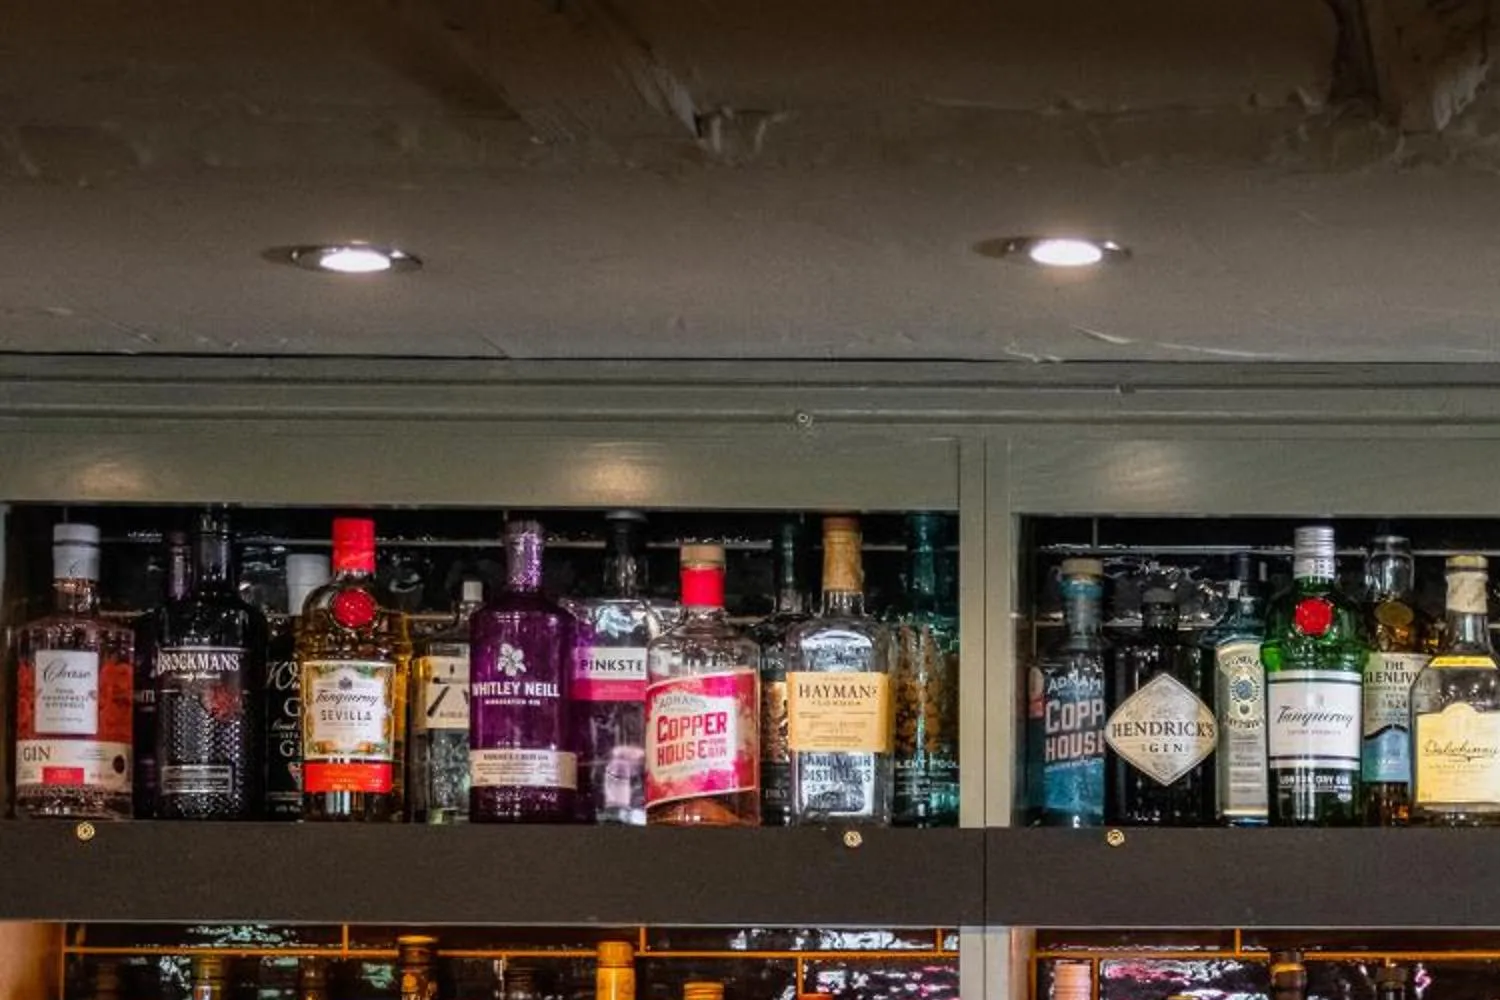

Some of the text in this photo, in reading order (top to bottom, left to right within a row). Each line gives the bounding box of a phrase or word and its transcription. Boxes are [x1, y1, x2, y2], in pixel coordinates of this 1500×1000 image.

[157, 652, 240, 675] BROCKMANS
[581, 658, 644, 672] PINKSTE
[1384, 661, 1404, 671] THE
[524, 683, 560, 698] NEILL
[1046, 673, 1103, 695] ADNAM
[320, 709, 373, 722] SEVILLA
[1045, 698, 1104, 734] COPP
[1276, 705, 1354, 728] Tanqueray
[656, 711, 728, 743] COPPER
[1111, 721, 1215, 739] HENDRICK'S
[23, 746, 50, 762] GIN
[656, 740, 707, 768] HOUSE
[1149, 743, 1183, 753] GIN
